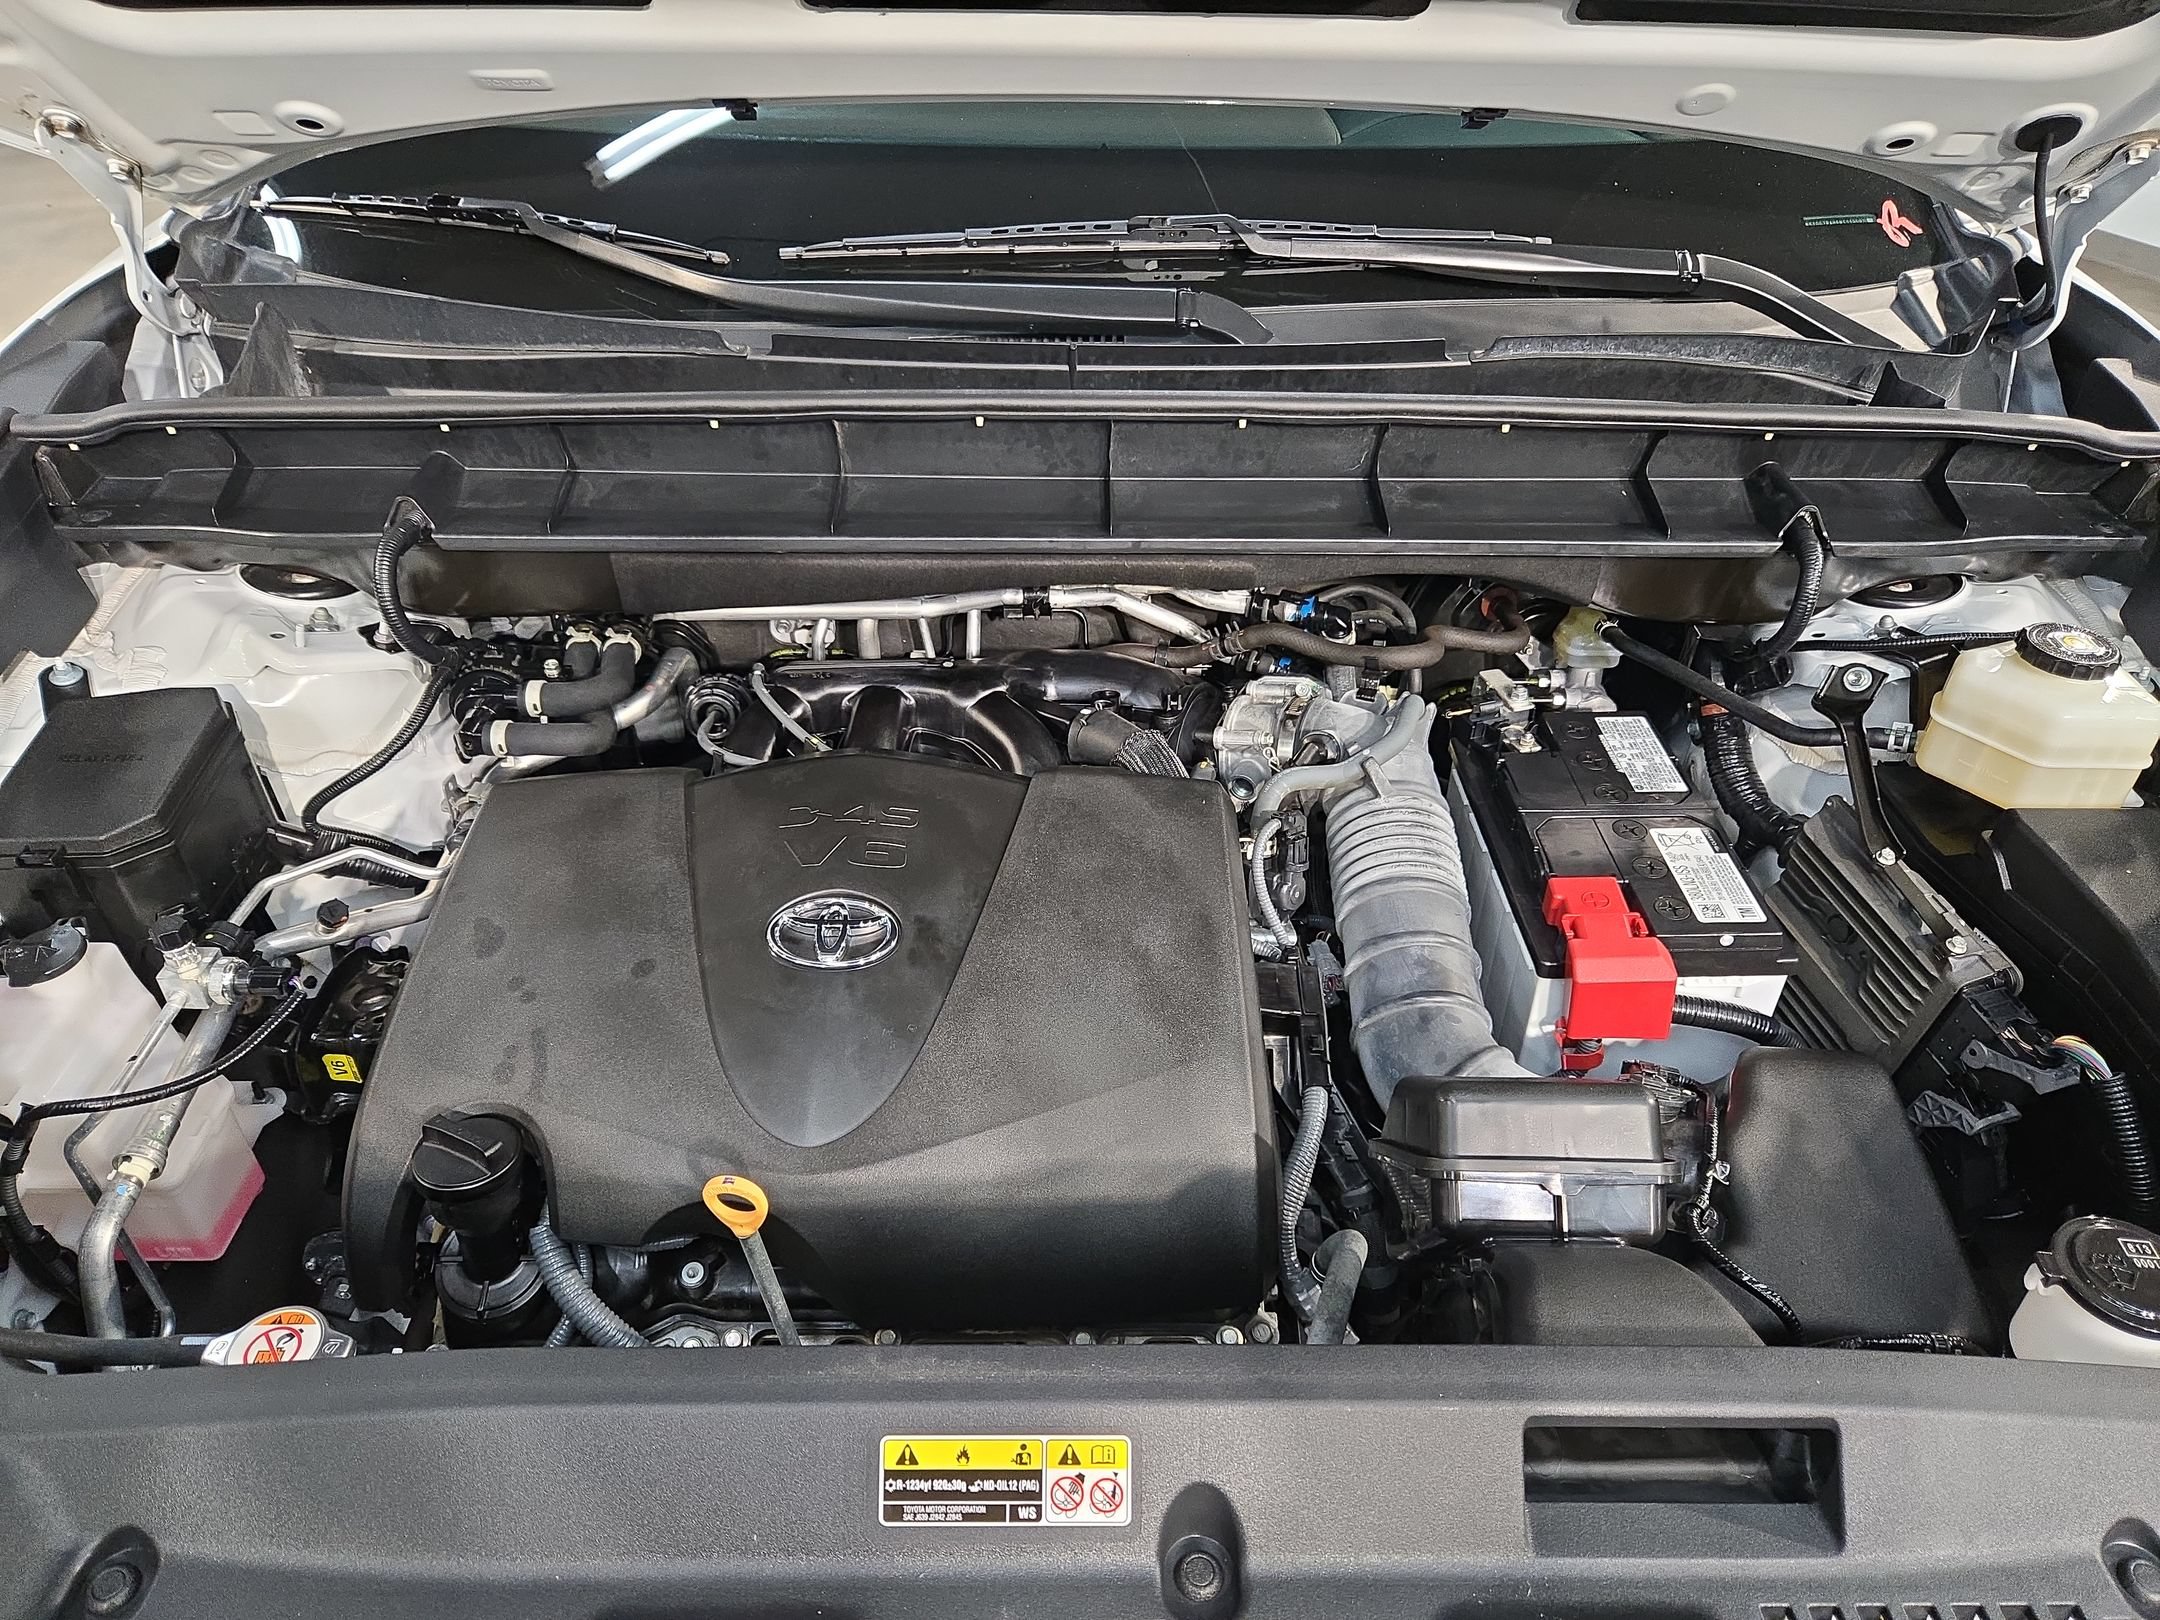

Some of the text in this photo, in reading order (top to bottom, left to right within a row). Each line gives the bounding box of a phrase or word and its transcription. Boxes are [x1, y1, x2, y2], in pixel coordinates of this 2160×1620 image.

[779, 804, 920, 829] D-4S
[784, 834, 908, 869] V6
[330, 1060, 349, 1076] V6
[2133, 1258, 2160, 1269] 0001
[902, 1505, 987, 1513] TOYOTA MOTOR CORPORATION
[1017, 1506, 1038, 1520] WS
[902, 1513, 915, 1521] SAE
